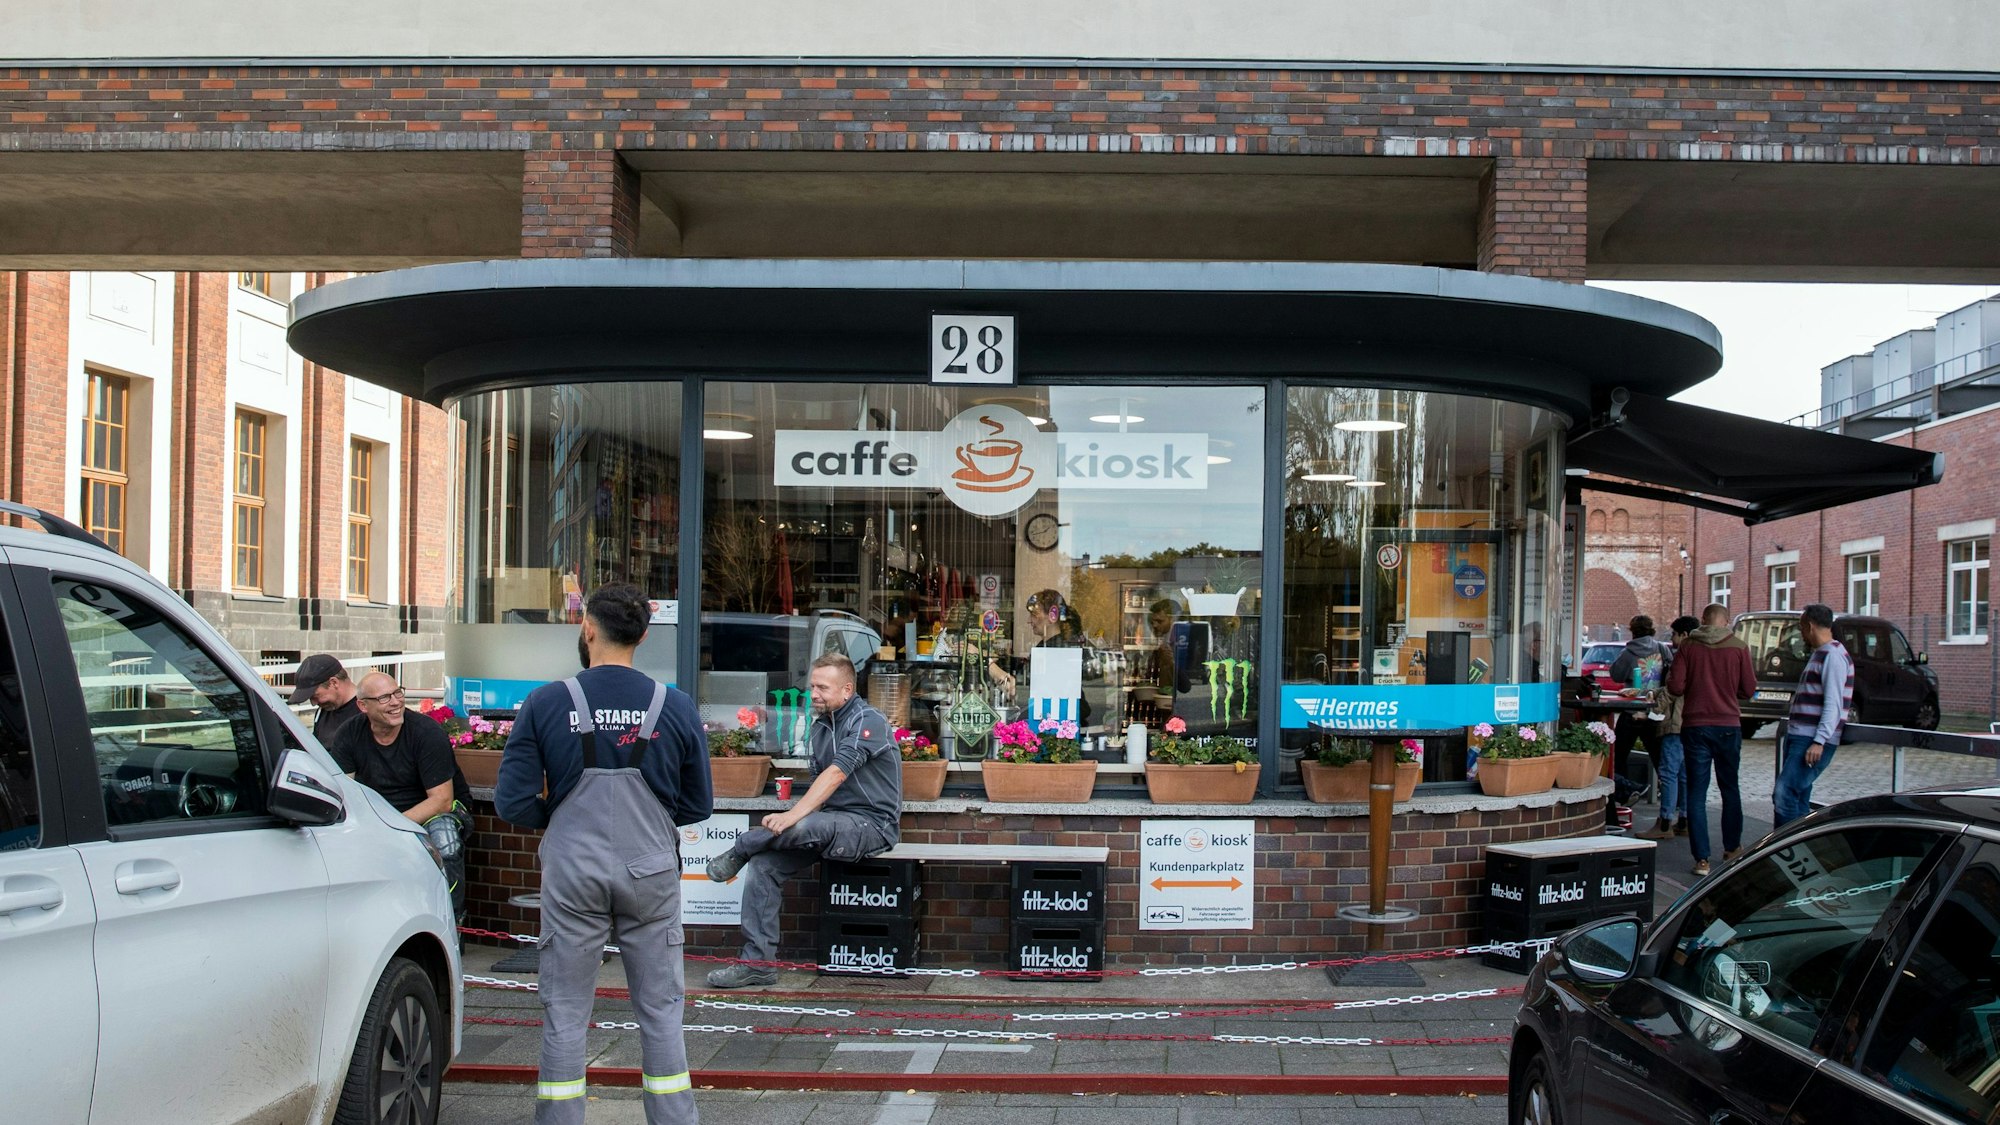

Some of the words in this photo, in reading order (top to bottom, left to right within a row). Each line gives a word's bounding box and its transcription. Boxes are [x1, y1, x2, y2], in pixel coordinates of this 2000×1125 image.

[940, 325, 1004, 374] 28
[791, 440, 917, 476] caffe
[1056, 443, 1194, 479] kiosk
[1320, 698, 1399, 716] Hermes
[569, 710, 594, 726] D.
[570, 724, 595, 733] KÄE
[953, 713, 991, 723] SALITOS
[706, 827, 743, 840] kiosk
[1146, 834, 1182, 846] caffe
[1211, 834, 1248, 846] kiosk
[1149, 861, 1245, 873] Kundenparkplatz
[829, 883, 898, 907] fritz-kola
[1538, 881, 1585, 905] fritz-kola
[1600, 874, 1646, 898] fritz-kola
[1021, 890, 1088, 911] fritz-kola
[829, 944, 894, 966] fritz-kola
[1020, 945, 1088, 967] fritz-kola
